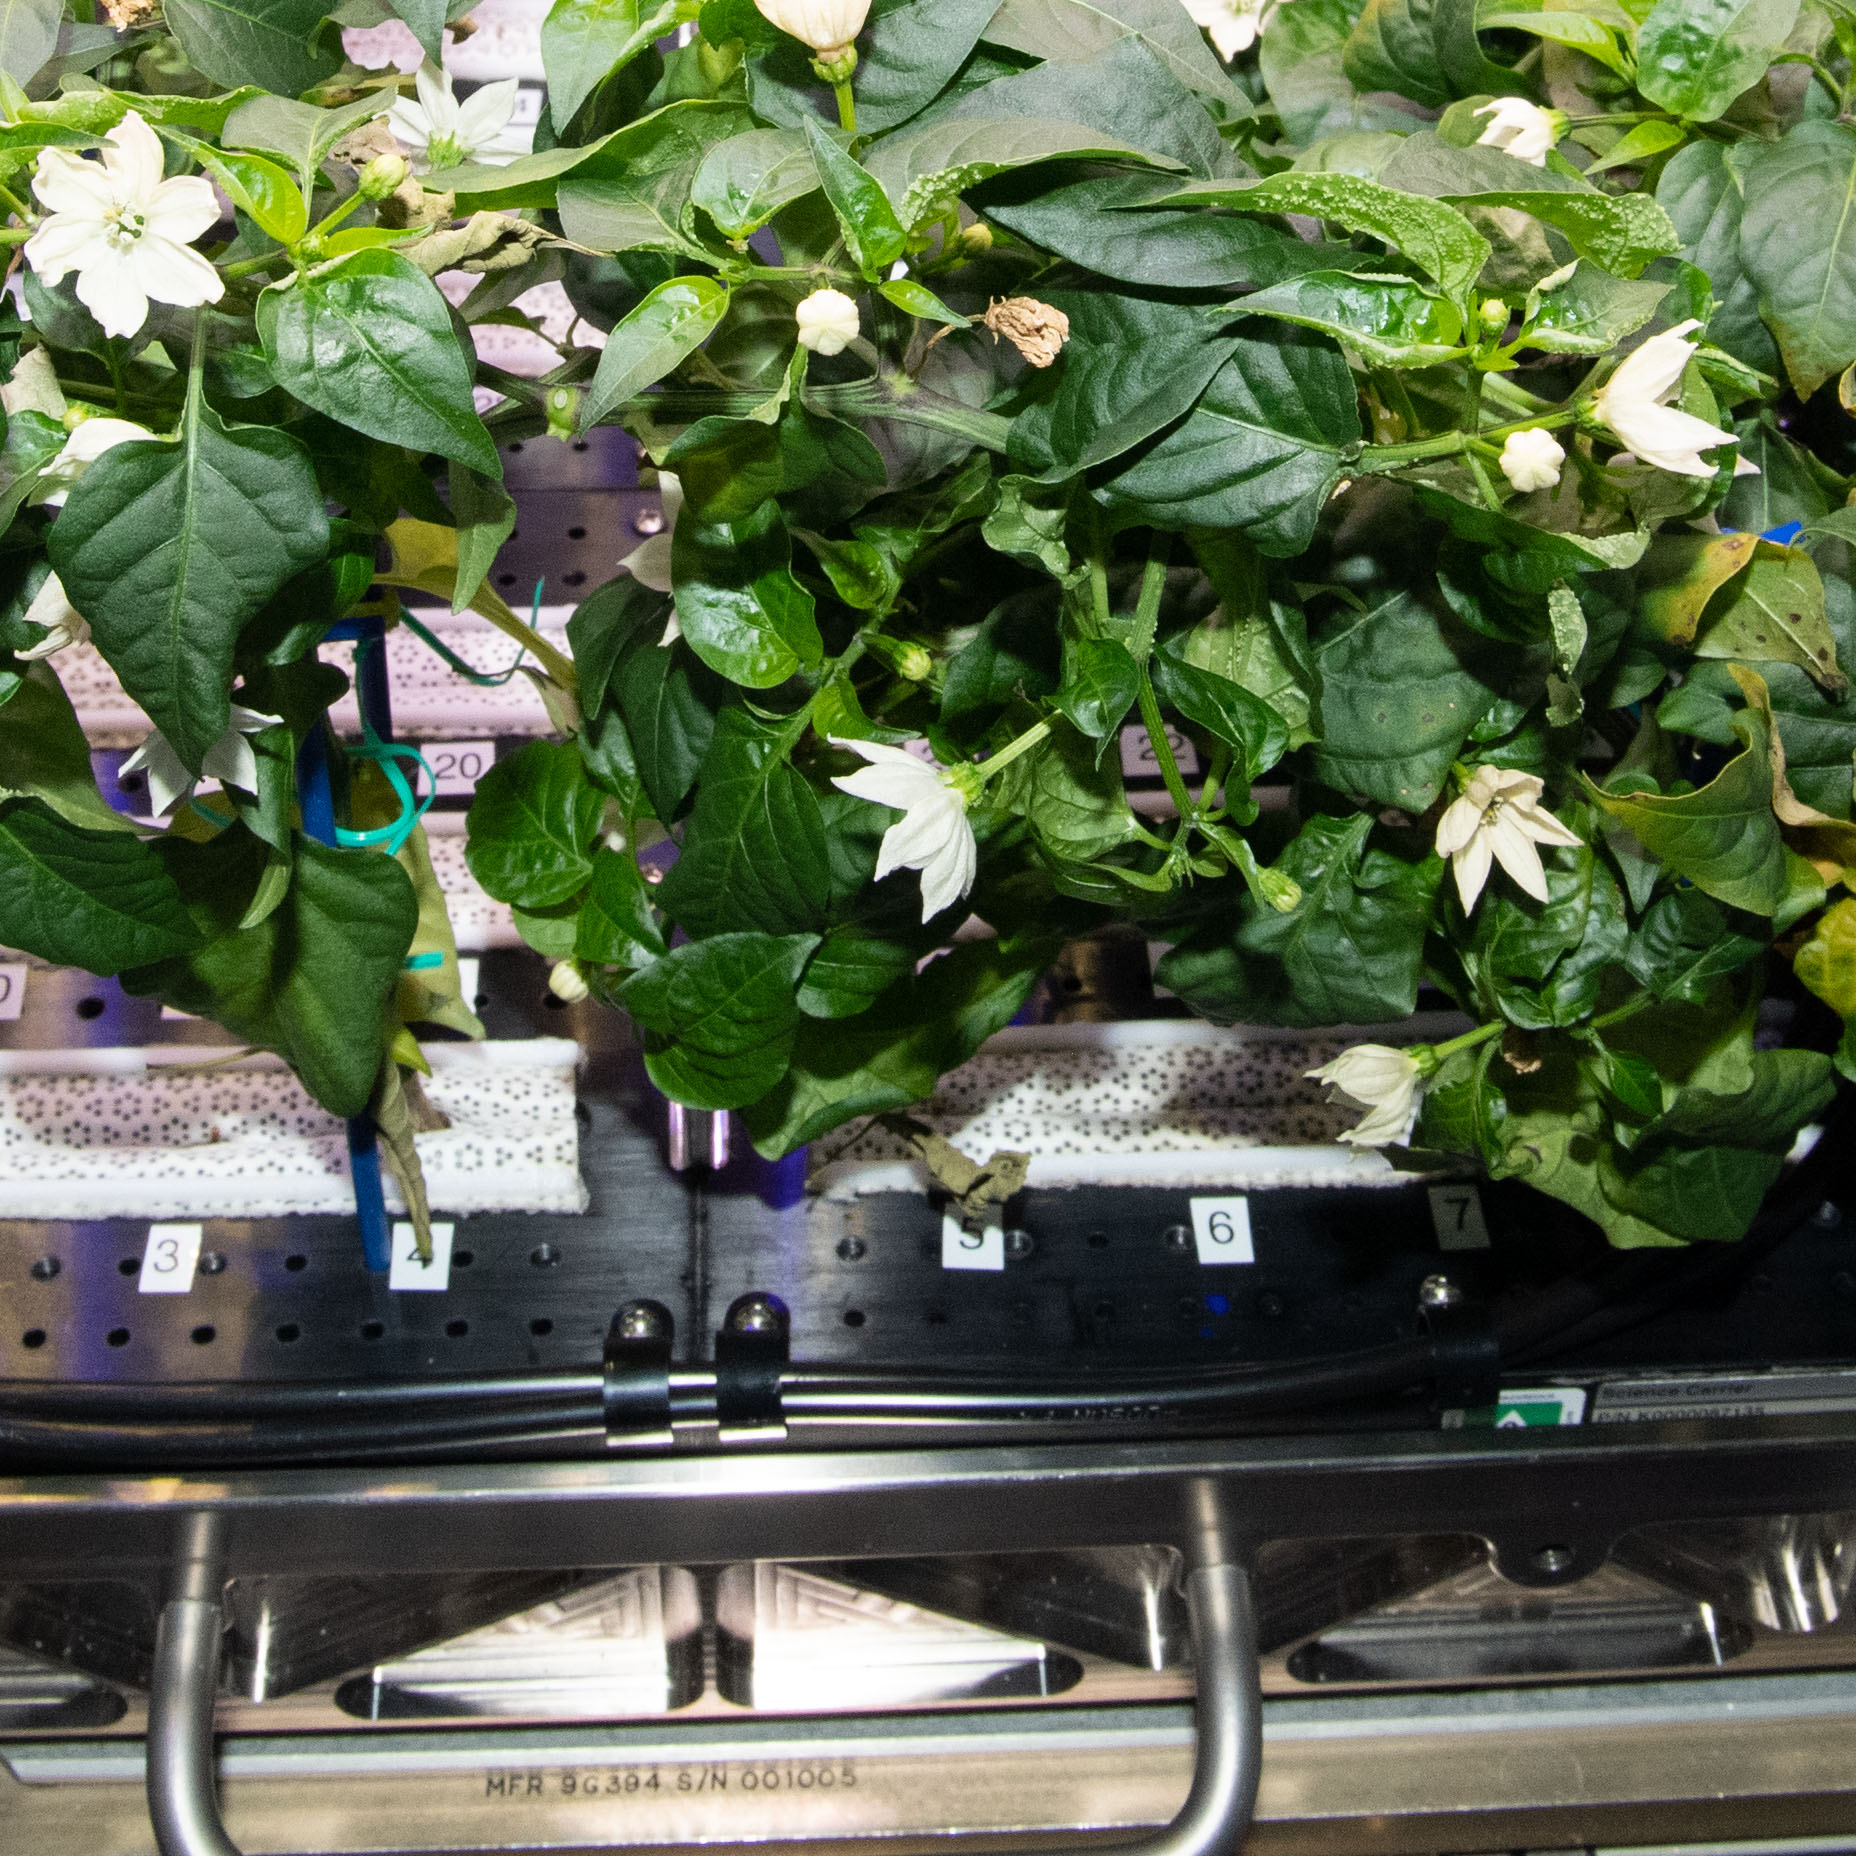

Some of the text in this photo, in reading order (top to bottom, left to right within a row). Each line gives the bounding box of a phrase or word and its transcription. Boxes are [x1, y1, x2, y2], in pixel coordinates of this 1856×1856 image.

[433, 752, 483, 781] 20
[1208, 1210, 1234, 1245] 6
[1444, 1197, 1470, 1231] 7
[153, 1239, 179, 1272] 3
[484, 1774, 544, 1797] MFR
[676, 1770, 728, 1792] S/N
[741, 1766, 858, 1791] 001005
